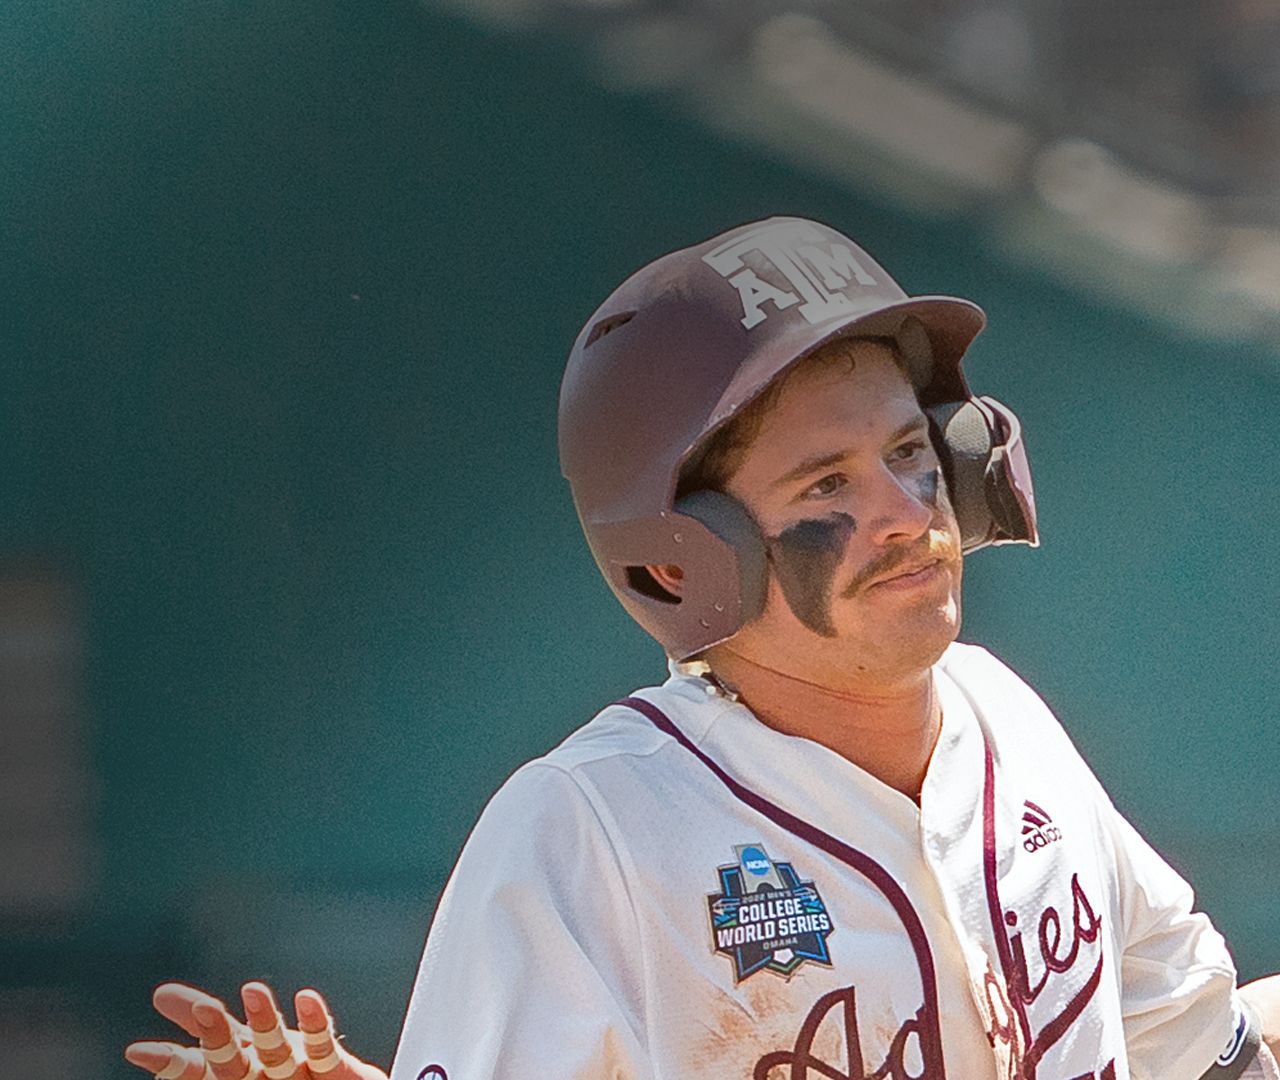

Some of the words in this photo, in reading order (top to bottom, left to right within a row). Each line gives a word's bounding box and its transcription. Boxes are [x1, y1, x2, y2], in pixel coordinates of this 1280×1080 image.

[738, 898, 804, 924] COLLEGE
[717, 921, 776, 948] WORLD
[778, 914, 830, 937] SERIES
[762, 937, 799, 950] OMAHA
